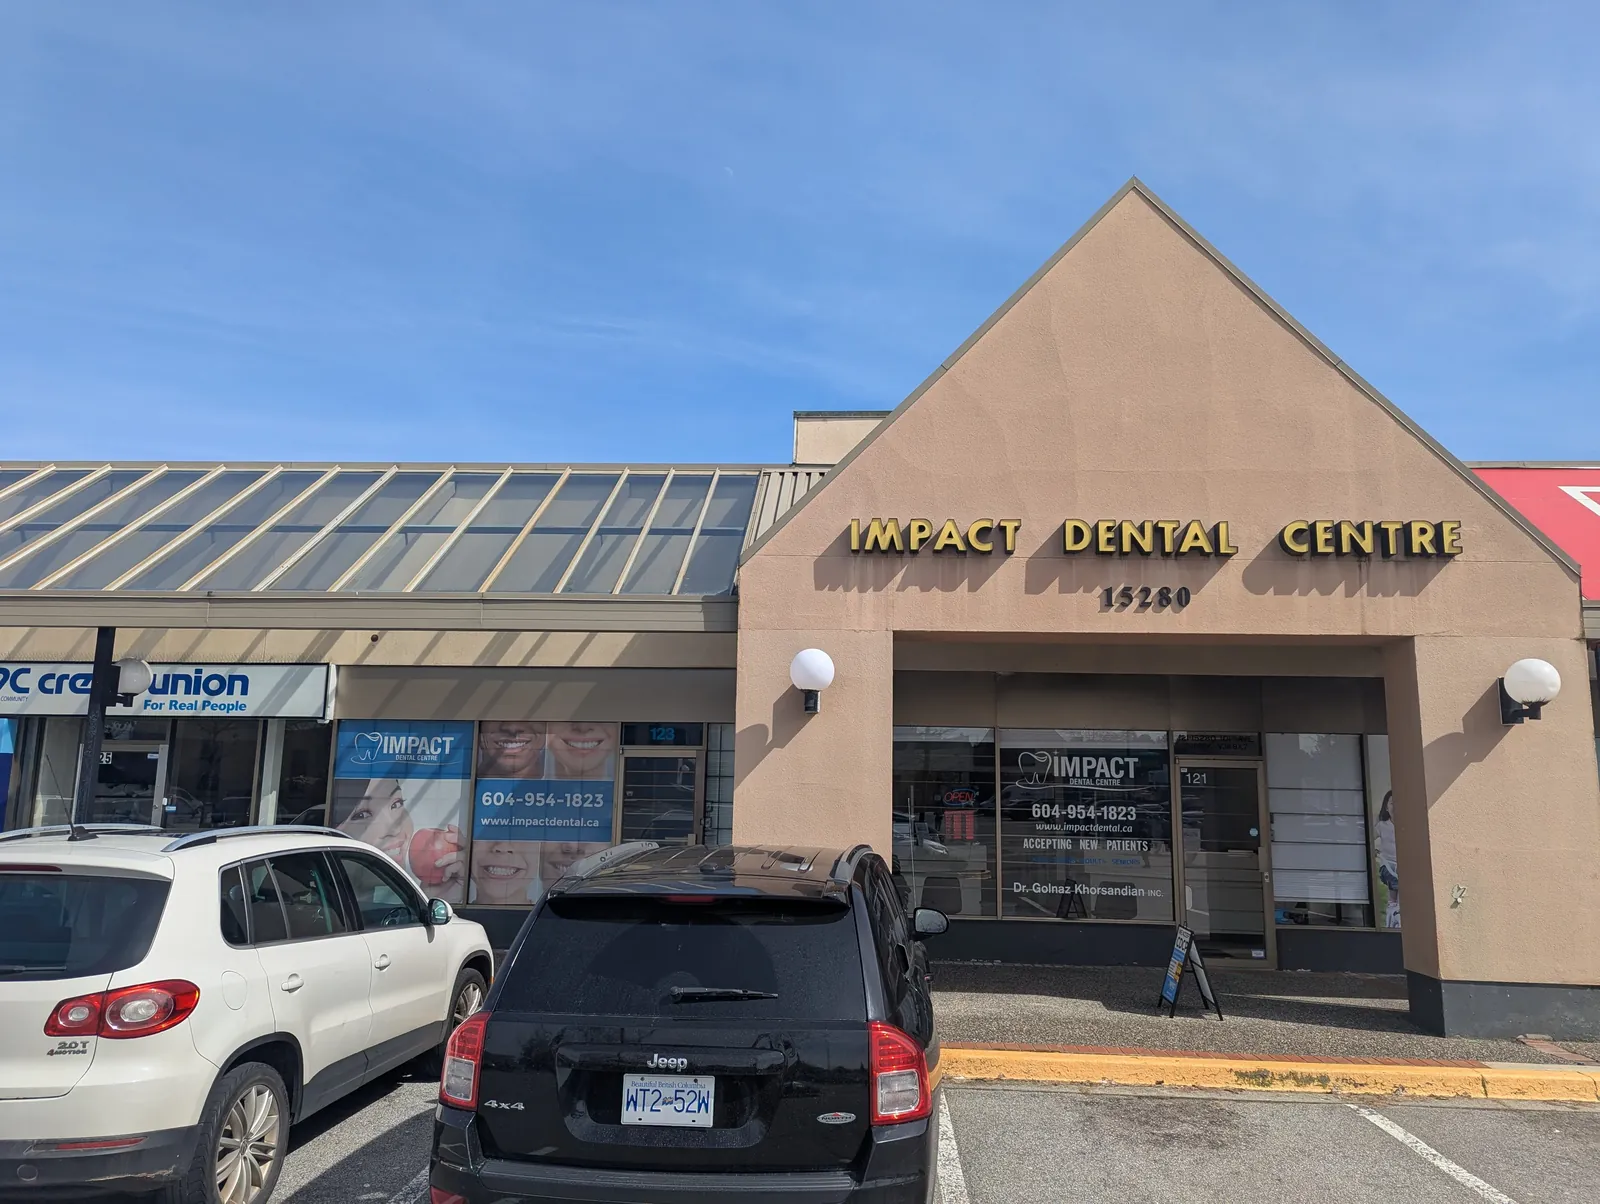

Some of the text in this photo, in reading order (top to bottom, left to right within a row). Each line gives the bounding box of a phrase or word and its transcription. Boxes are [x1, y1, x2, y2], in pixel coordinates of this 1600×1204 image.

[850, 518, 1463, 558] IMPACT DENTAL CENTRE
[1103, 586, 1191, 608] 15280
[148, 668, 250, 696] union
[143, 699, 247, 714] For Real People
[650, 727, 675, 741] 123
[382, 736, 455, 754] IMPACT
[1053, 754, 1139, 779] IMPACT
[1069, 778, 1121, 786] DENTAL CENTRE
[1185, 772, 1207, 784] 121
[481, 791, 604, 808] 604-954-1823
[944, 791, 975, 803] OPEN
[1031, 803, 1137, 821] 604-954-1823
[480, 816, 600, 828] www.impactdental.ca
[1035, 822, 1133, 833] www.impactdental.ca
[1023, 838, 1149, 852] ACCEPTING NEW PATIENTS
[1013, 882, 1164, 897] Dr. Golnaz Khorsandian INC.
[646, 1053, 688, 1072] Jeep
[631, 1080, 657, 1088] Beautiful
[483, 1099, 525, 1111] 4x4
[625, 1088, 710, 1114] WT2 52W
